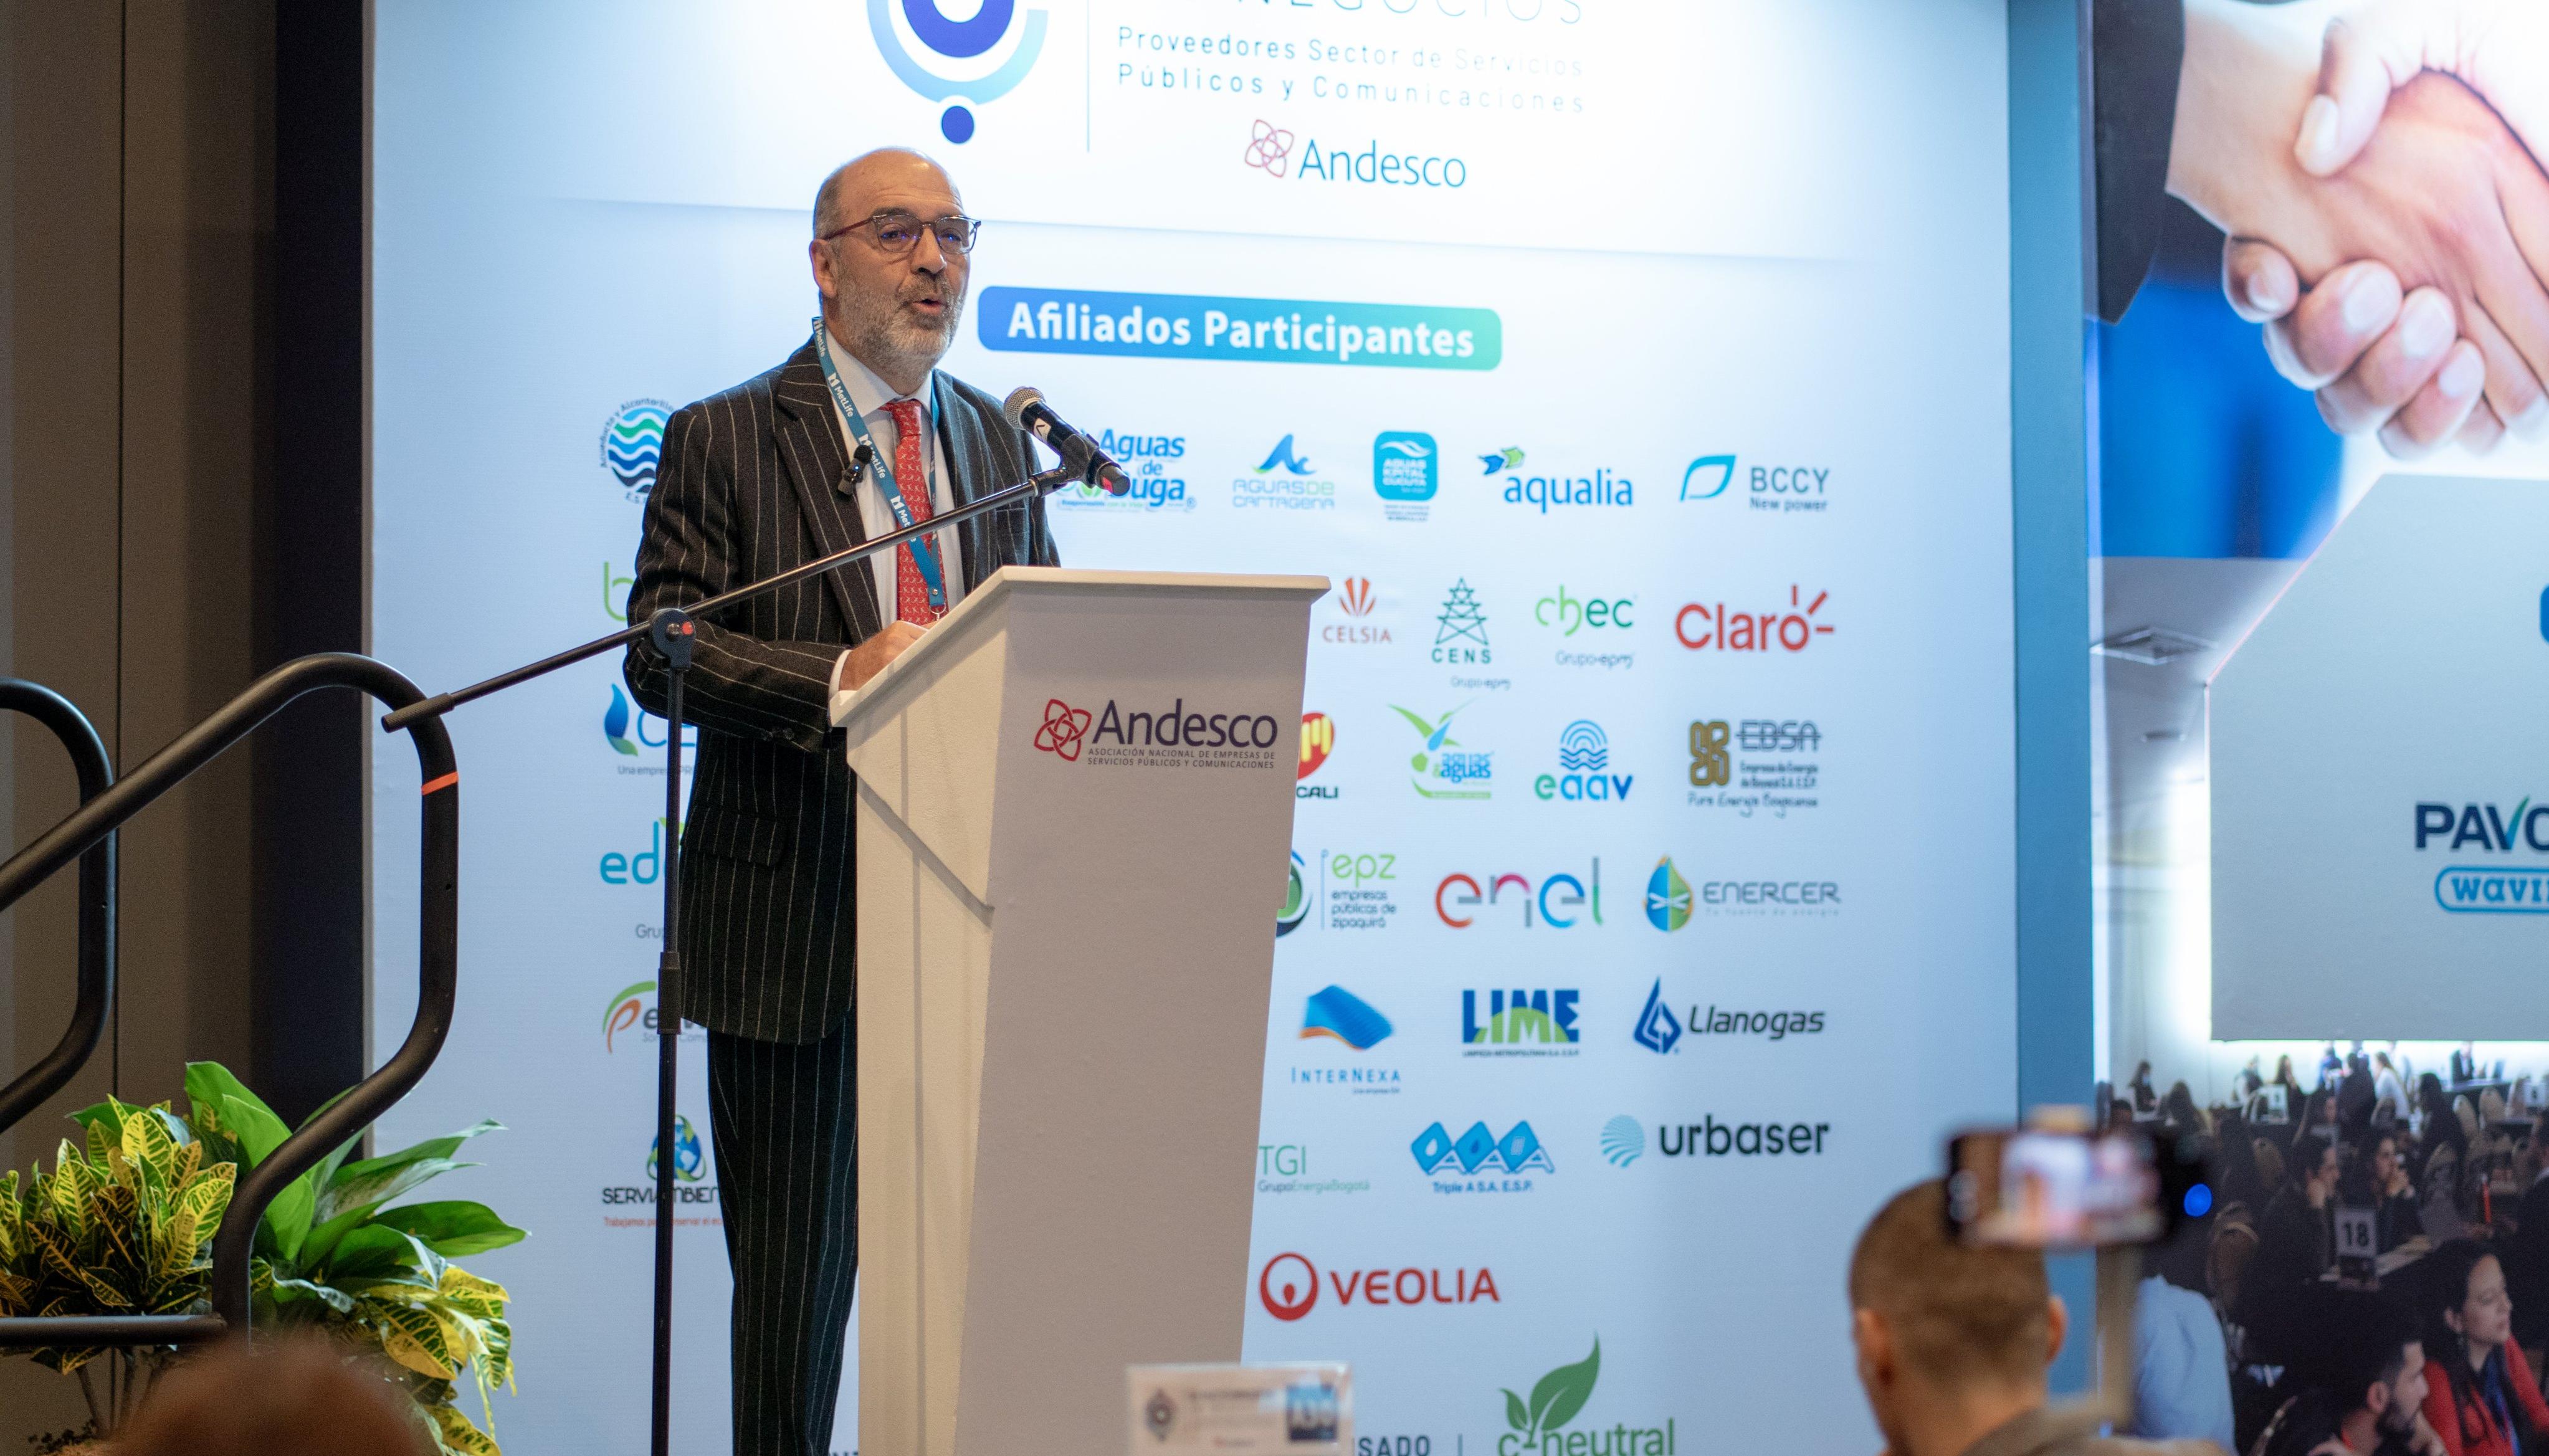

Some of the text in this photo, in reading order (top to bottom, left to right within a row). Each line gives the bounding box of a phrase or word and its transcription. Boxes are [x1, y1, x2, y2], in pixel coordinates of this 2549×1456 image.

[1118, 27, 1583, 77] Proveedores Sector de Servicios
[1118, 64, 1583, 113] Públicos y Comunicaciones
[1299, 140, 1465, 188] Andesco
[1008, 300, 1474, 361] Afiliados Participantes
[834, 386, 853, 417] MetLife
[1100, 429, 1185, 462] Aguas
[1141, 460, 1163, 476] de
[1750, 466, 1829, 493] BCCY
[1111, 477, 1185, 507] uga
[1503, 469, 1634, 514] aqualia
[1536, 584, 1634, 636] chec
[1675, 599, 1811, 651] Claro
[1322, 626, 1392, 643] CELSIA
[1431, 648, 1492, 664] CENS
[1092, 698, 1278, 748] Andesco
[1736, 720, 1822, 751] EBSA
[1088, 757, 1274, 769] SERVICIOS PÚBLICOS Y COMUNICACIONES
[1089, 748, 1275, 759] ASOCIACIÓN NACIONAL DE EMPRESAS DE
[1296, 786, 1338, 799] CALI
[1535, 774, 1632, 801] eaav
[1332, 854, 1396, 888] epz
[1332, 890, 1388, 900] empresas
[1436, 856, 1604, 929] enel
[1703, 881, 1842, 904] ENERCER
[1381, 904, 1396, 914] de
[1463, 989, 1579, 1043] LIME
[1689, 1004, 1826, 1040] Llanogas
[1659, 1113, 1830, 1156] urbaser
[1259, 1145, 1306, 1175] TGI
[2345, 1222, 2368, 1246] 18
[1330, 1267, 1500, 1305] VEOLIA
[1357, 1435, 1431, 1456] SADO
